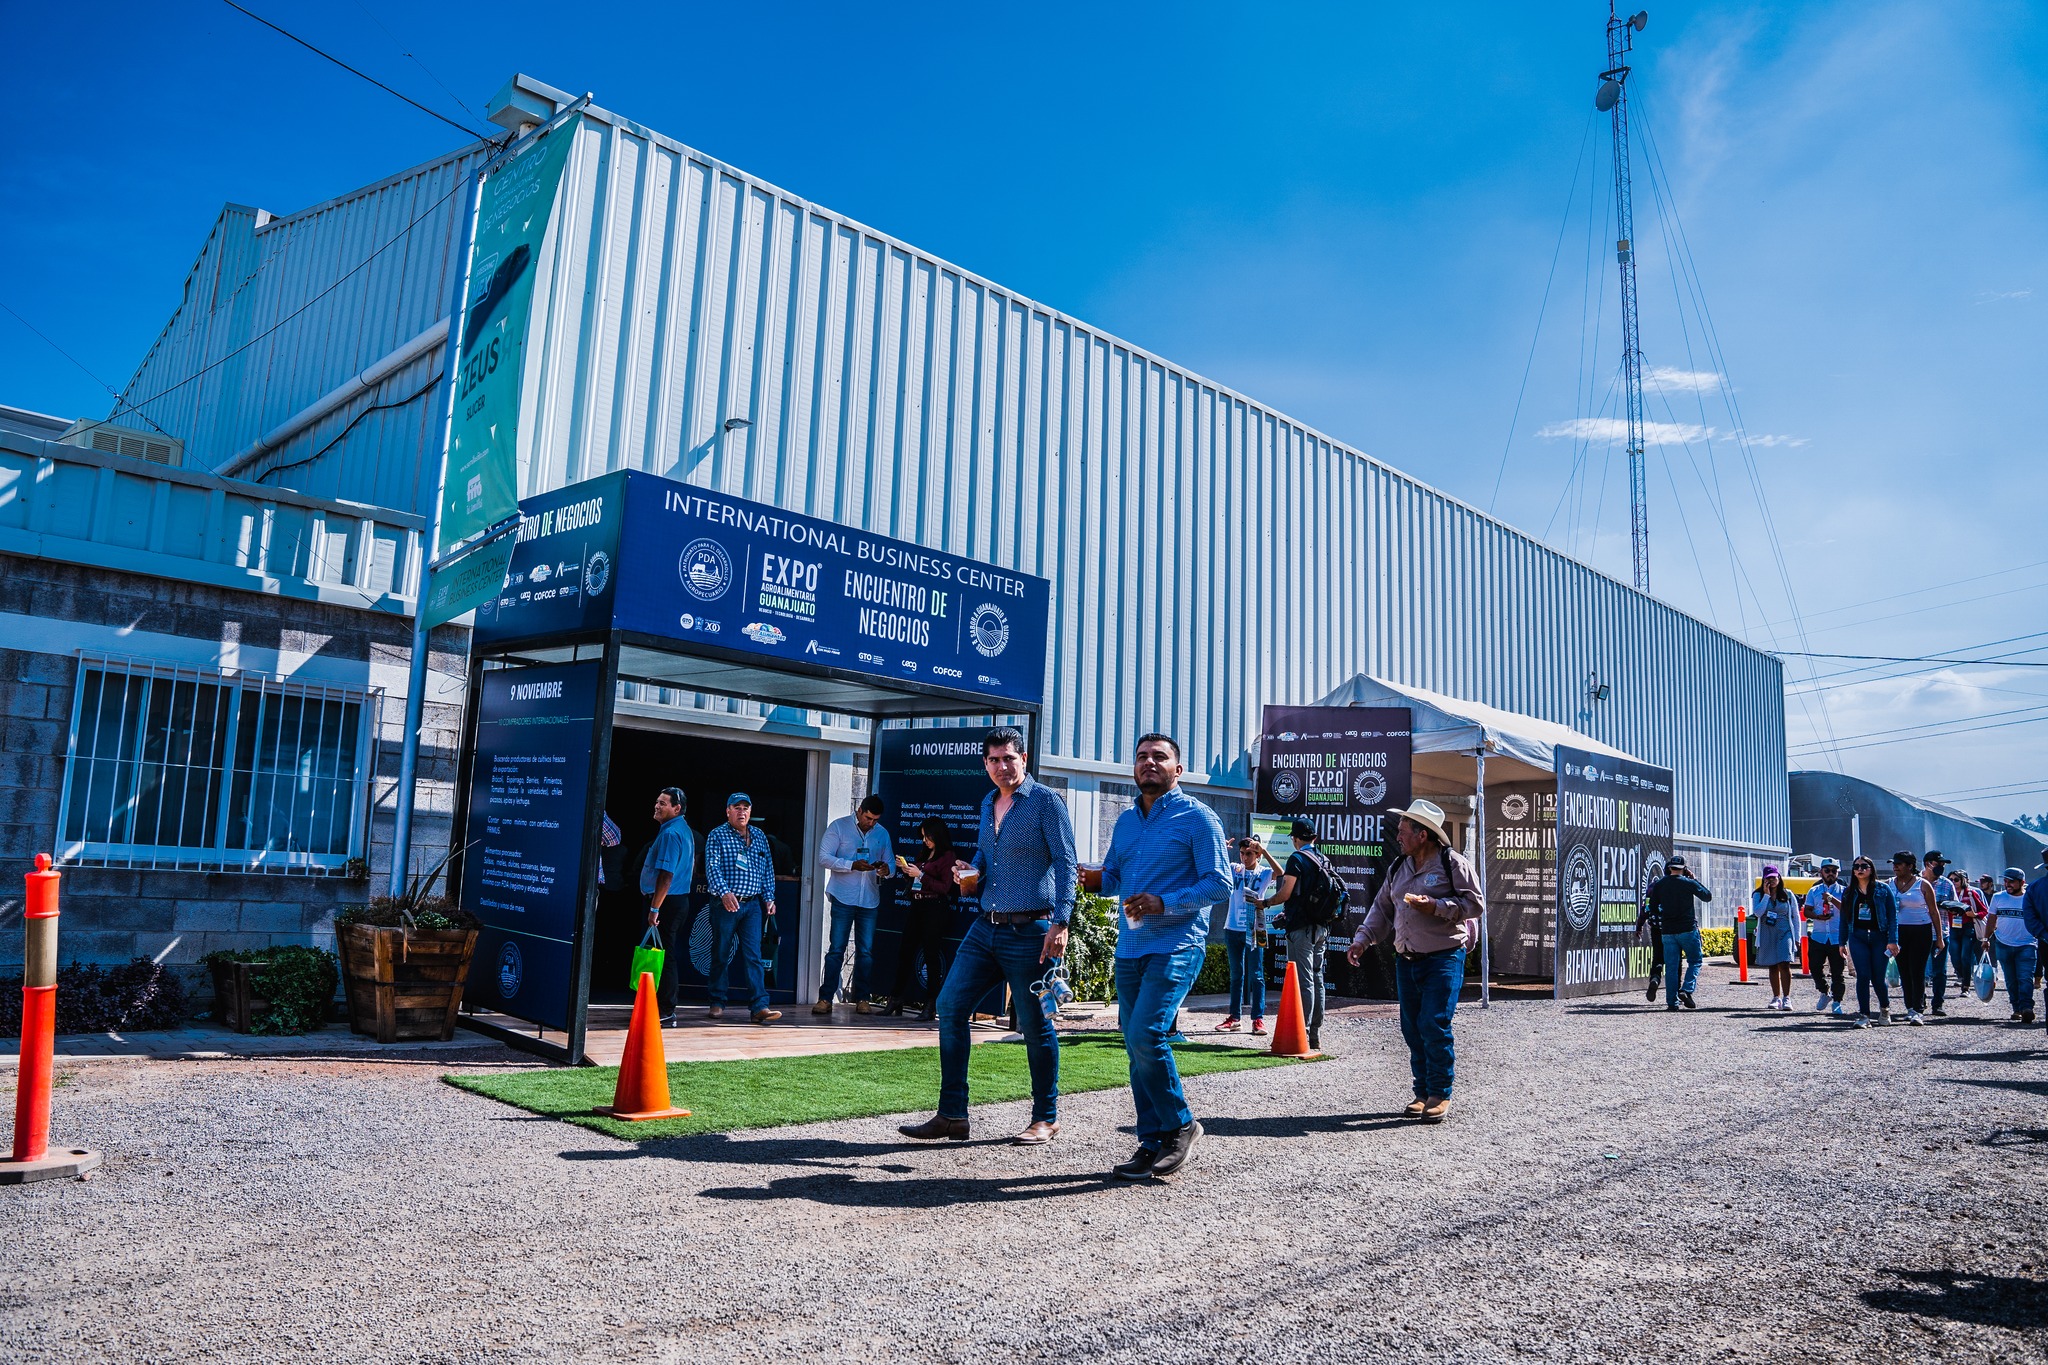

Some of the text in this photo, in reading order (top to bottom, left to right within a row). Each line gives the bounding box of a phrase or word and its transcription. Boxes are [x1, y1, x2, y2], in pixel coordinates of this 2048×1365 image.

[494, 146, 548, 196] CENTRO
[461, 337, 500, 401] ZEUS
[466, 394, 486, 422] SLICER
[541, 510, 554, 537] DE
[555, 496, 603, 534] NEGOCIOS
[664, 490, 1025, 598] INTERNATIONAL BUSINESS CENTER
[698, 553, 716, 565] PDA
[762, 552, 819, 592] EXPO
[686, 580, 724, 598] AGROPECUARIO
[761, 582, 816, 602] AGROALIMENTARIA
[844, 570, 948, 618] ENCUENTRO DE
[759, 592, 816, 616] GUANAJUATO
[859, 607, 930, 647] NEGOCIOS
[858, 652, 872, 661] GTO
[510, 681, 563, 701] 9 NOVIEMBRE
[532, 716, 570, 725] INTERNACIONALES
[909, 742, 984, 756] 10 NOVIEMBRE
[1272, 752, 1387, 768] ENCUENTRO DE NEGOCIOS
[1310, 770, 1344, 787] EXPO
[1308, 793, 1344, 802] GUANAJUATO
[1564, 790, 1670, 838] ENCUENTRO DE NEGOCIOS
[1356, 866, 1375, 874] frescos
[1574, 867, 1586, 878] PDA
[1601, 845, 1636, 888] EXPO
[1600, 888, 1636, 902] AGROALIMENTARIA
[1600, 903, 1637, 923] GUANAJUATO
[1565, 946, 1626, 985] BIENVENIDOS
